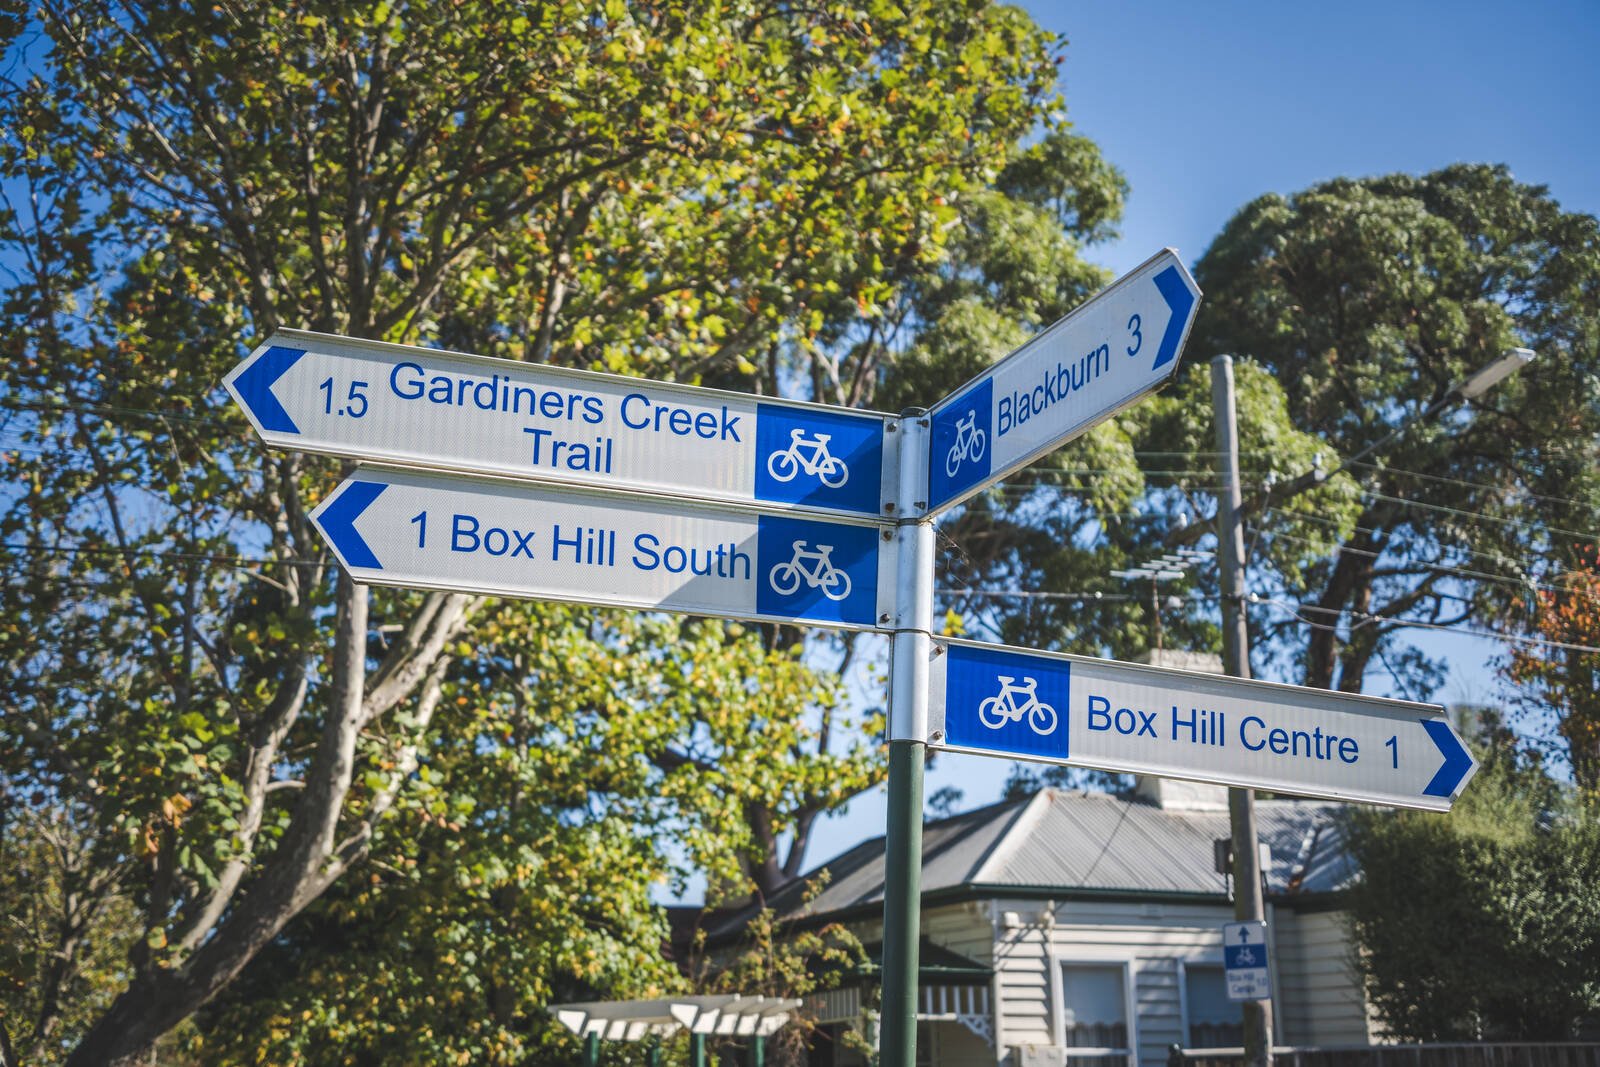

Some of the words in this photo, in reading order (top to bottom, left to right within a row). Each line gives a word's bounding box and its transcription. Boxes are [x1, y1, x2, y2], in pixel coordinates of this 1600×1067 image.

[319, 376, 368, 418] 1.5
[390, 362, 603, 424] Gardiners
[621, 394, 740, 443] Creek
[998, 343, 1109, 437] Blackburn
[1127, 315, 1142, 356] 3
[523, 428, 613, 474] Trail
[411, 512, 427, 549] 1
[451, 514, 534, 561] Box
[552, 525, 616, 567] Hill
[632, 533, 751, 579] South
[1088, 696, 1157, 738] Box
[1172, 706, 1225, 747] Hill
[1240, 716, 1360, 764] Centre
[1385, 735, 1399, 769] 1
